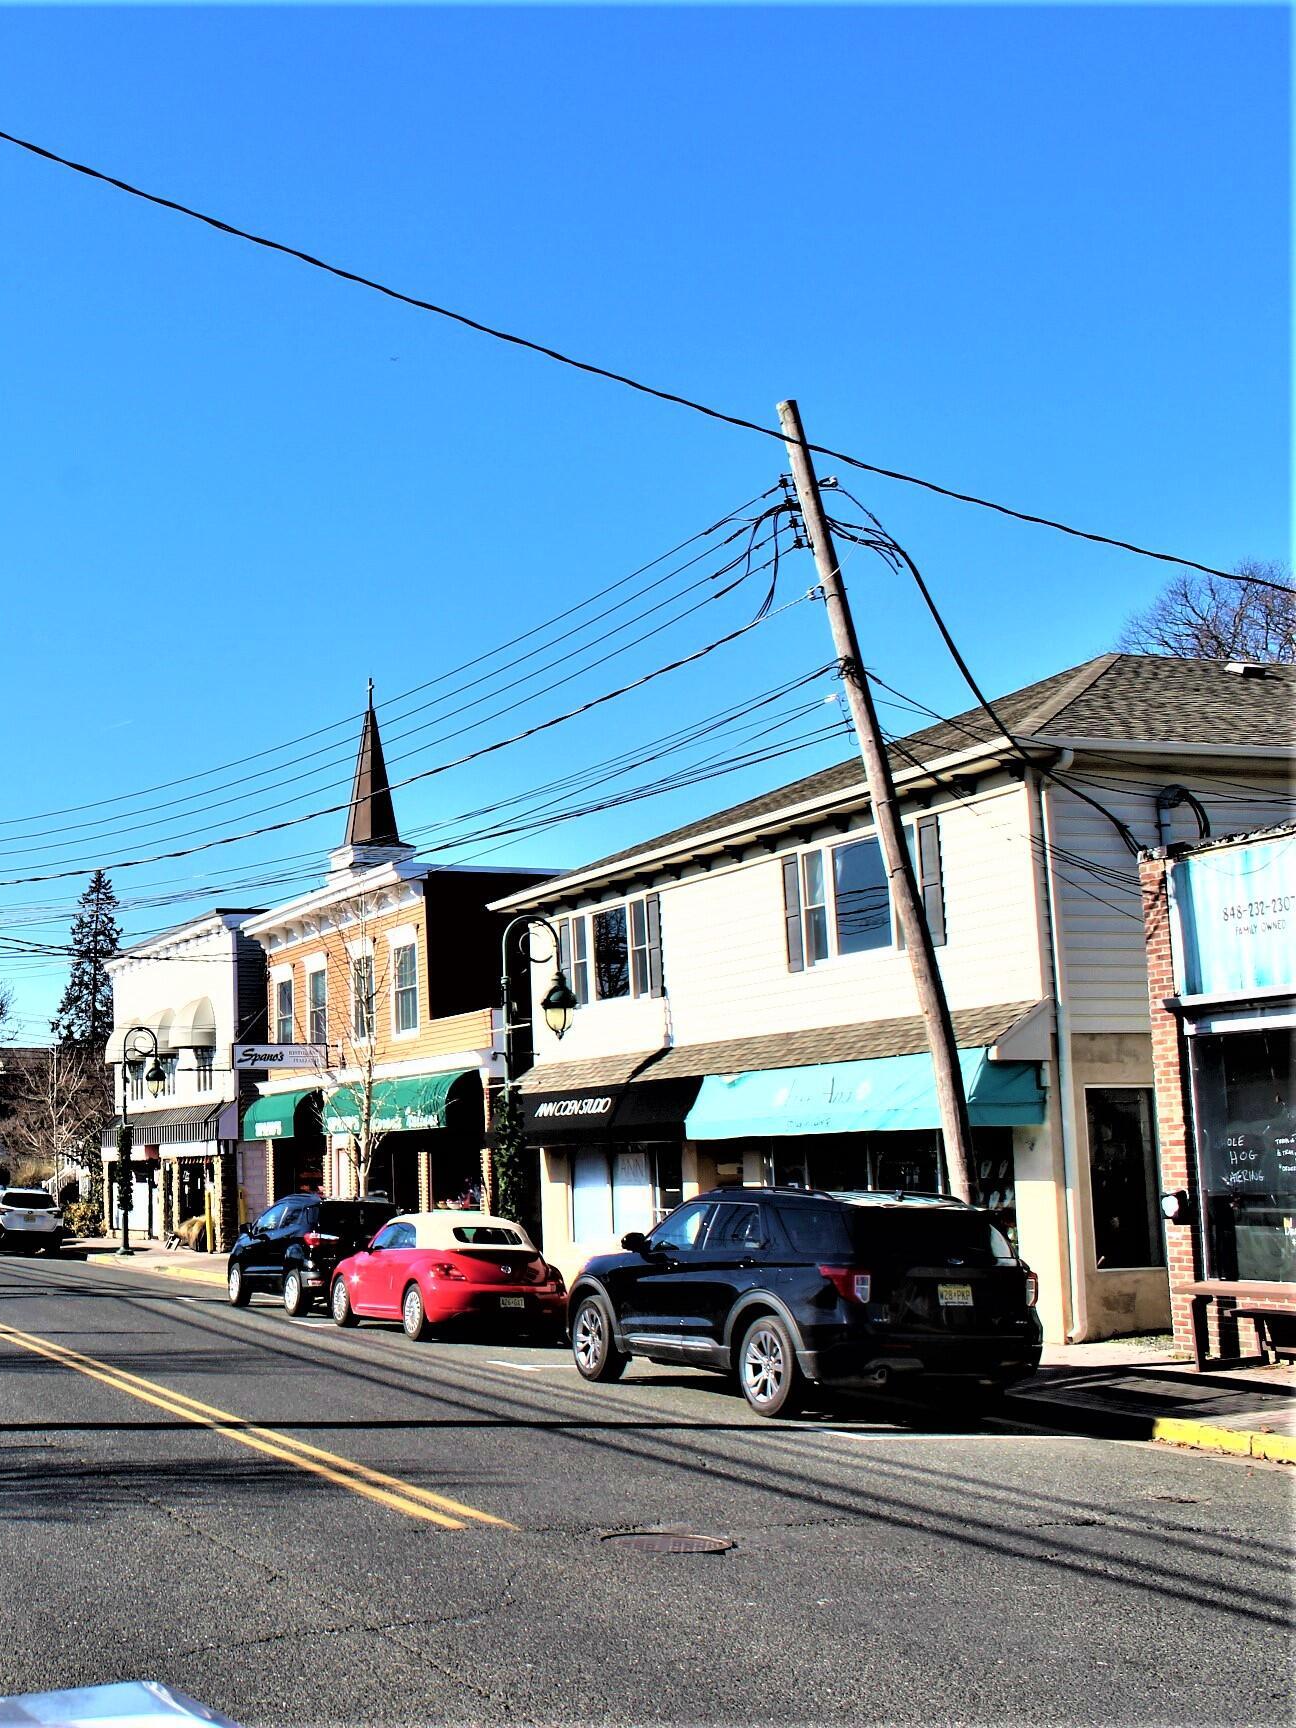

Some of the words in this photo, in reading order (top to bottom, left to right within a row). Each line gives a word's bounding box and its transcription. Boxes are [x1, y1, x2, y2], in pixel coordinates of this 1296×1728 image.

[1223, 895, 1296, 921] 848-232-230
[1261, 919, 1286, 933] OWNED
[237, 1047, 285, 1066] Spano's
[1229, 1149, 1258, 1165] HOG
